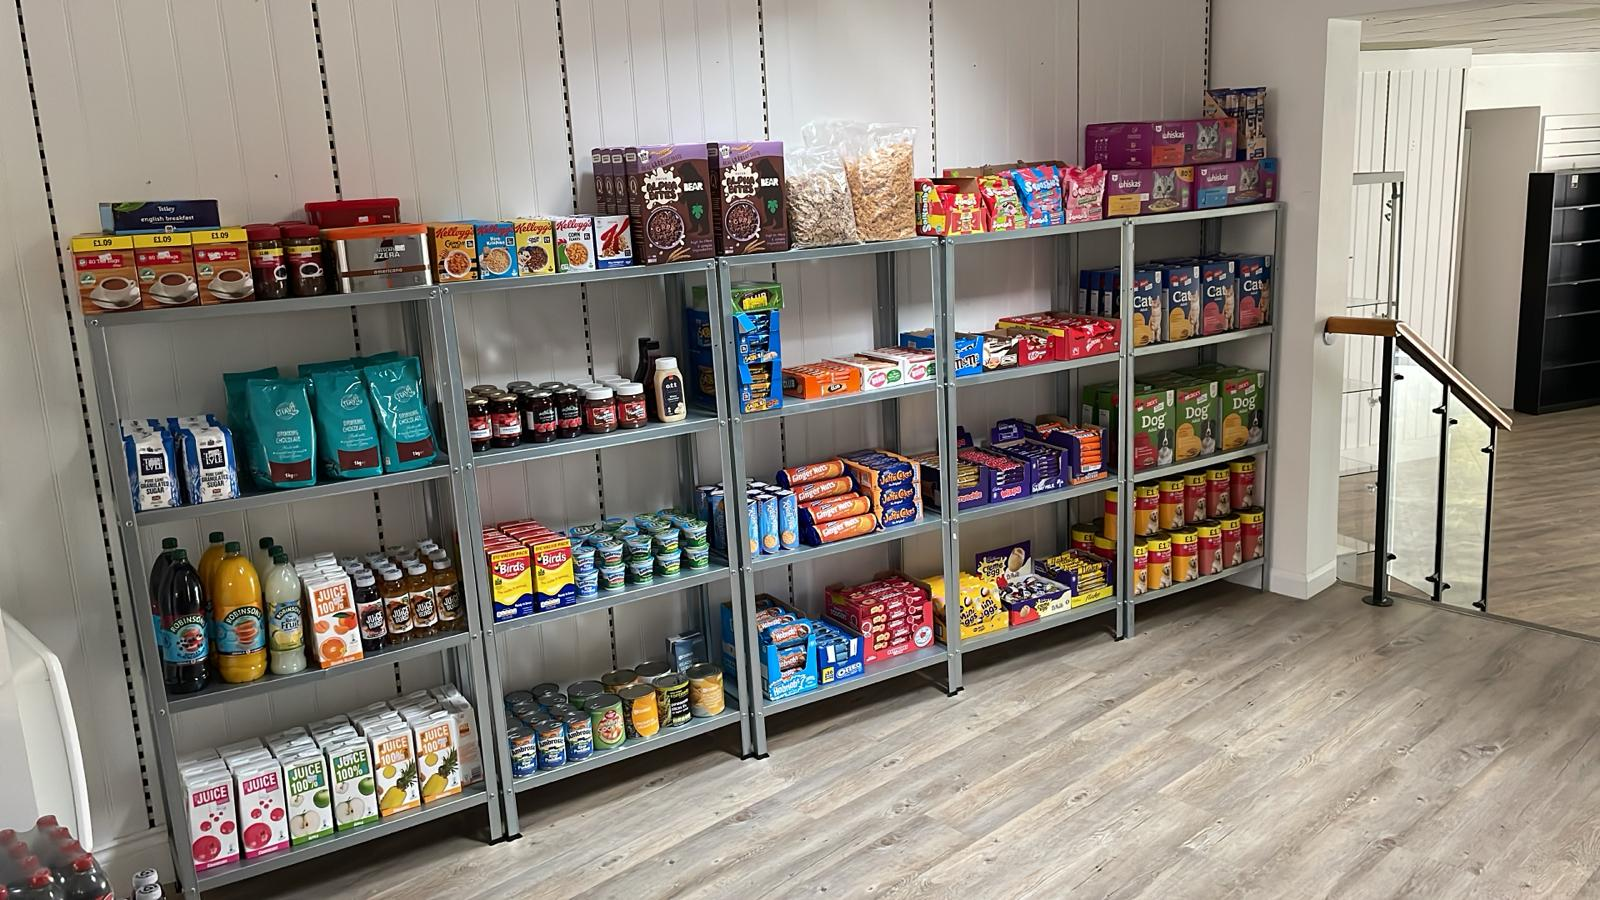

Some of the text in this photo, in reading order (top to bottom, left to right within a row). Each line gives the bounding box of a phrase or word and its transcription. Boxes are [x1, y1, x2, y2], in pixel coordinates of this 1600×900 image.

[1161, 128, 1185, 140] whiskas
[760, 177, 779, 187] BEAR
[1118, 180, 1142, 189] whiskas
[1206, 173, 1229, 182] whiskas
[683, 182, 704, 192] BEAR
[157, 205, 176, 214] Tetley
[165, 214, 194, 222] breakfast
[556, 219, 592, 231] Kellogg's
[436, 226, 473, 240] Kellogg's
[514, 221, 552, 234] Kellogg's
[153, 235, 172, 243] £1.09
[211, 231, 229, 240] £1.09
[93, 239, 112, 247] £1.09
[373, 267, 403, 275] americano
[1206, 285, 1228, 298] Cat
[1243, 279, 1264, 292] Cat
[1133, 295, 1153, 308] Cat
[1172, 290, 1193, 303] Cat
[1232, 393, 1258, 410] Dog
[1185, 402, 1211, 420] Dog
[1141, 411, 1168, 430] Dog
[791, 464, 828, 482] Ginger Nuts
[880, 472, 897, 485] Jaffa
[896, 470, 913, 480] Cakes
[798, 481, 836, 501] Ginger Nuts
[881, 488, 914, 504] Jaffa Cakes
[957, 491, 982, 502] runchie
[816, 500, 853, 520] Ginger Nuts
[883, 507, 916, 523] Jaffa Cakes
[822, 517, 860, 537] Ginger Nuts
[542, 552, 567, 565] Bird's
[500, 561, 525, 574] Bird's
[986, 568, 1000, 577] egg
[317, 584, 346, 601] JUICE
[317, 600, 344, 615] 100%
[226, 607, 262, 624] ROBINSONS
[963, 612, 978, 627] ggs
[776, 627, 798, 639] Hobnobs
[781, 655, 798, 667] obnobs
[836, 662, 862, 679] OREO
[773, 679, 800, 695] Hobnobs
[422, 725, 450, 742] JUICE
[380, 736, 408, 753] JUICE
[291, 762, 322, 781] JUICE
[336, 764, 364, 781] 100%
[246, 774, 277, 793] JUICE
[291, 780, 319, 796] 100%
[196, 787, 228, 804] JUICE
